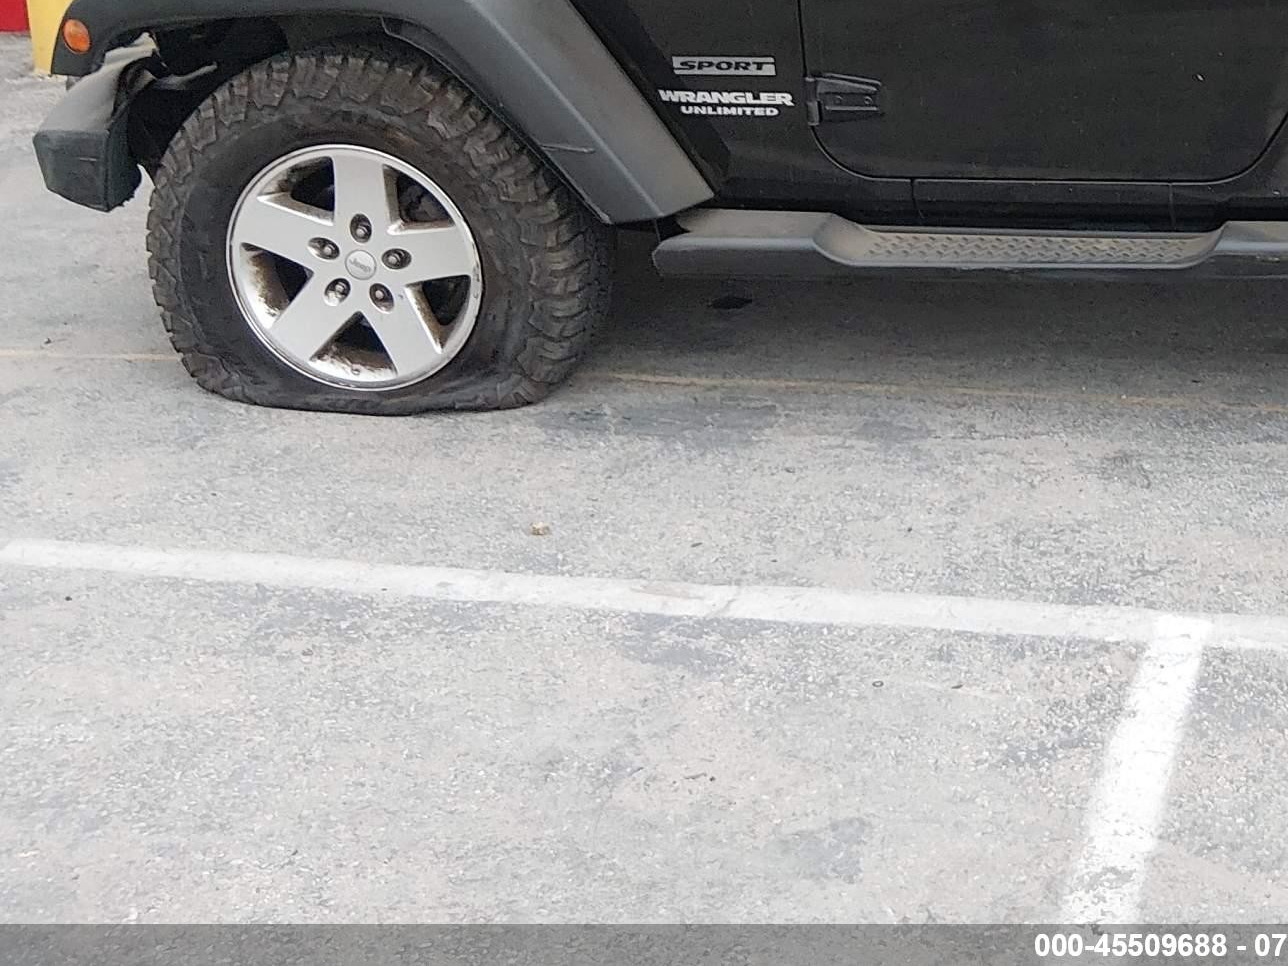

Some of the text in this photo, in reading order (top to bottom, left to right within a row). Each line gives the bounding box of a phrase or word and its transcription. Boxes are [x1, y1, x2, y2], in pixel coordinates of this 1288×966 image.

[673, 59, 775, 72] SPORT
[658, 89, 795, 106] WRANGLER
[680, 106, 780, 117] UNLIMITED
